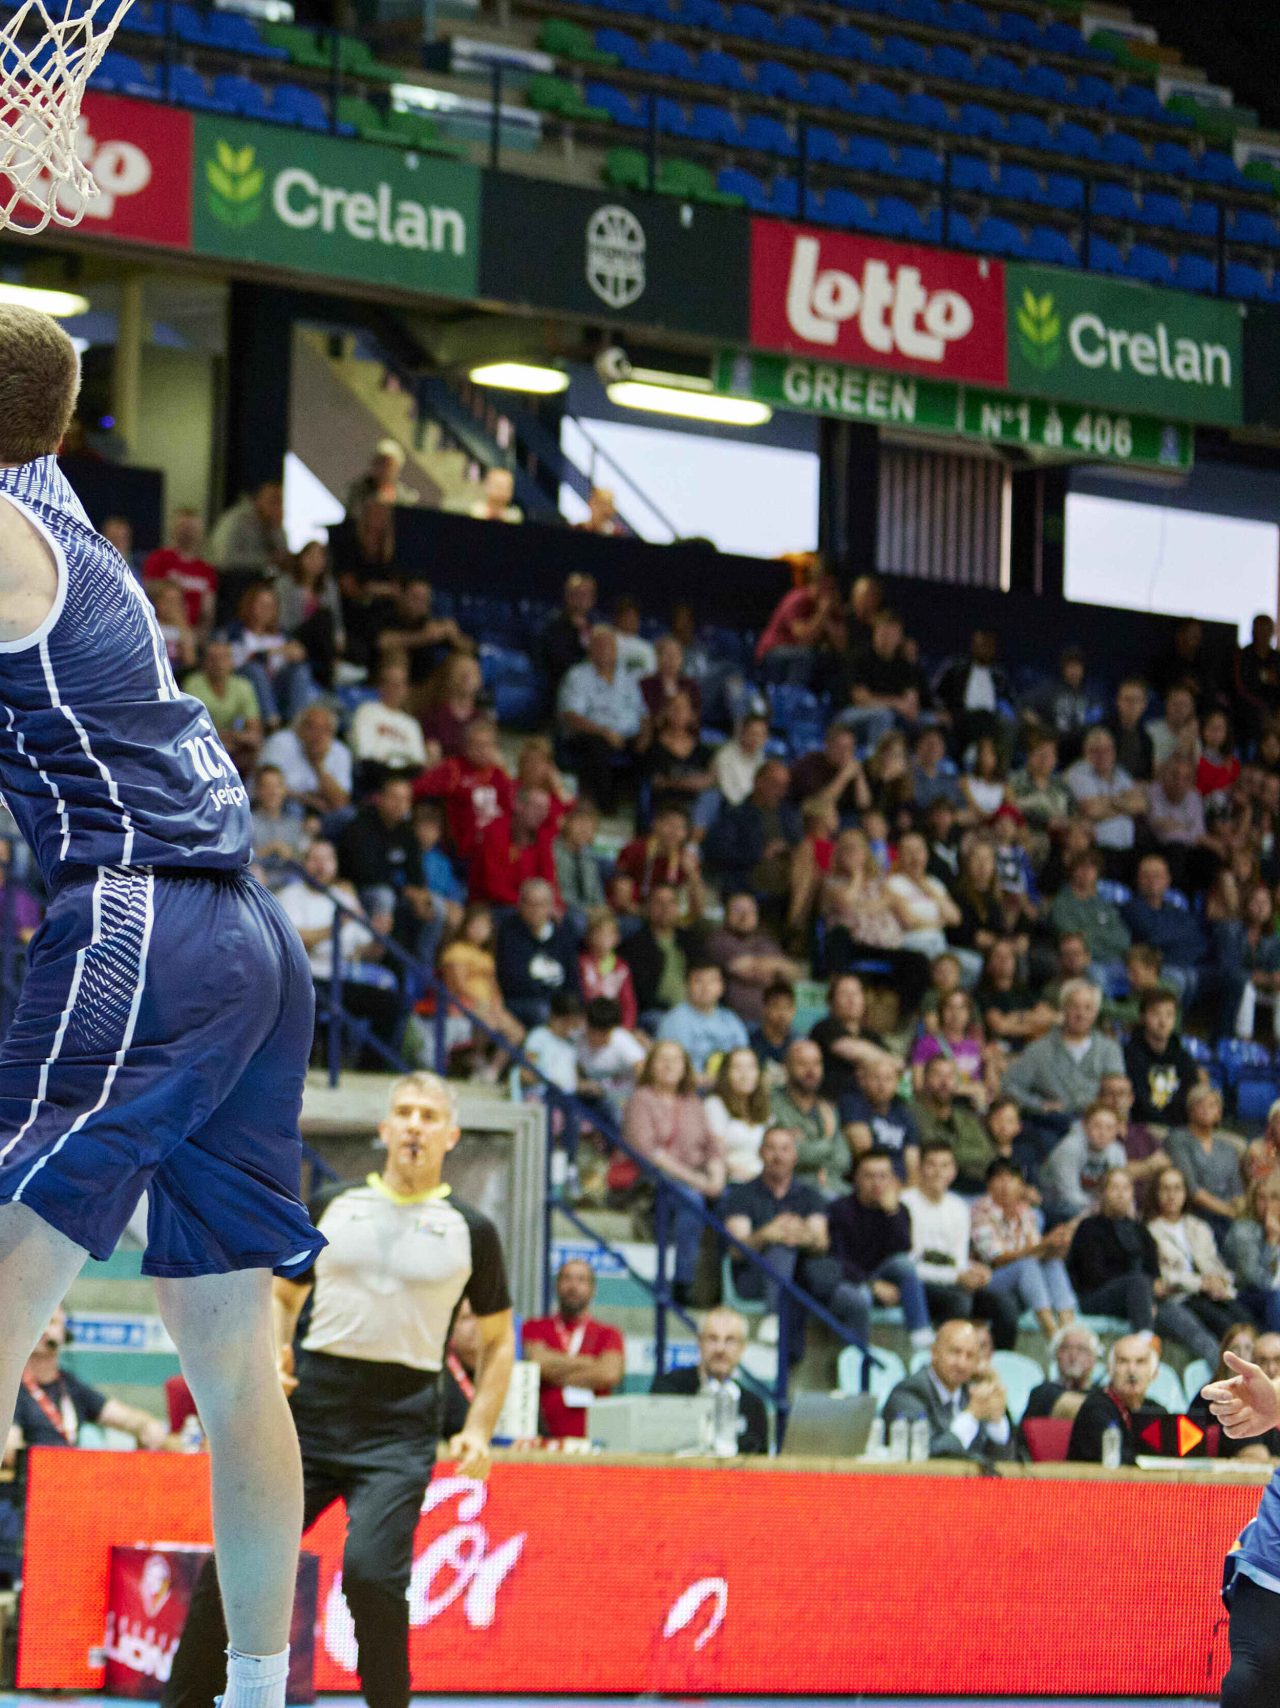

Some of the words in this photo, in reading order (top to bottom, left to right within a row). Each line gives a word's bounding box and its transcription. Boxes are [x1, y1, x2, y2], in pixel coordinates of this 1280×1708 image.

[273, 168, 466, 256] Crelan
[1069, 313, 1232, 388] Crelan
[783, 366, 917, 421] GREEN
[1073, 412, 1132, 458] 406
